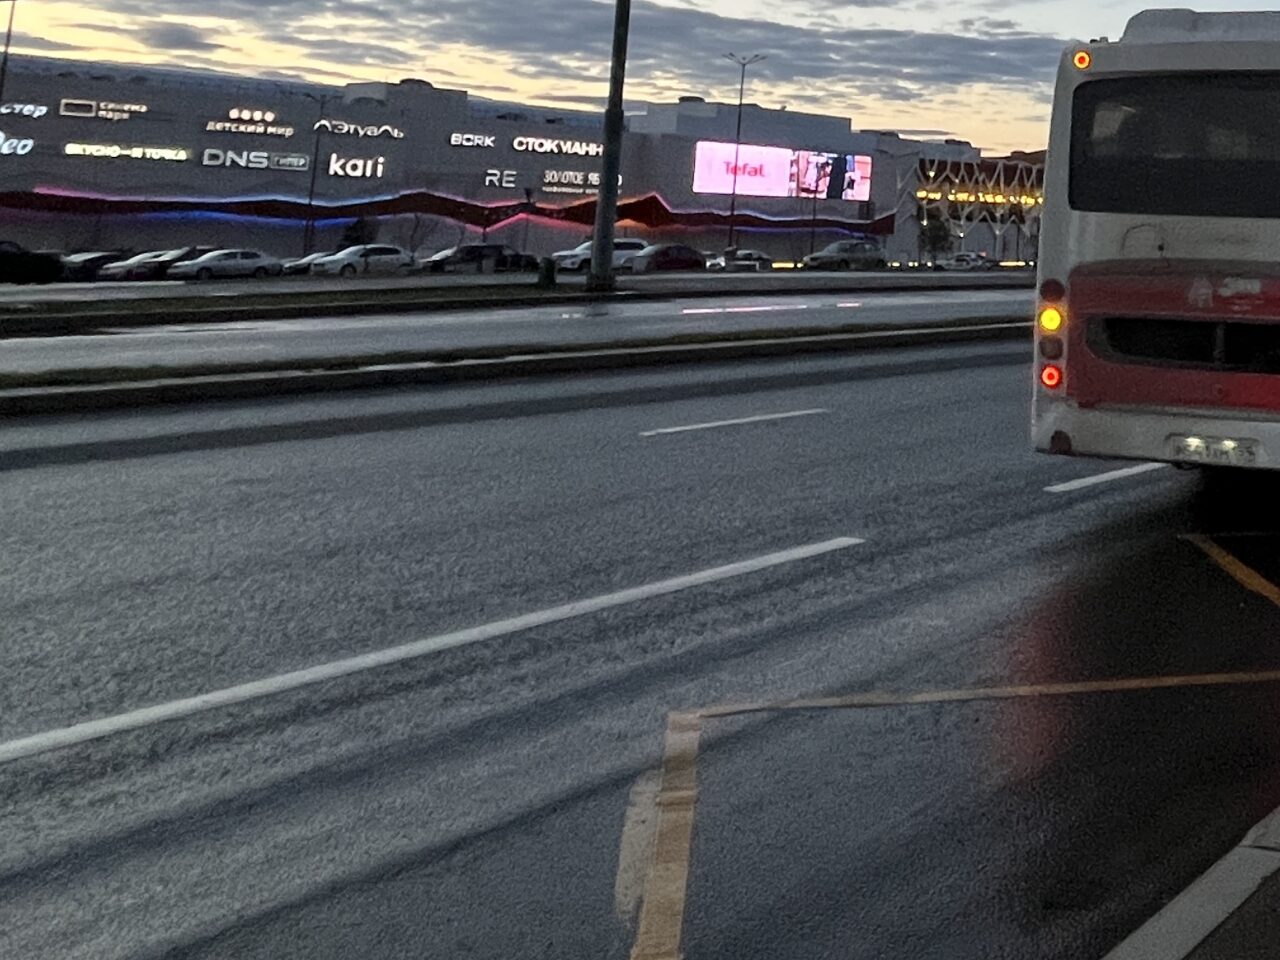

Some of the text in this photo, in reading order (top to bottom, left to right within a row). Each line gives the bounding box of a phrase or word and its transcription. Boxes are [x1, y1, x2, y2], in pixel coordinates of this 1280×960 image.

[206, 121, 295, 138] детский мир
[450, 133, 496, 147] BORK
[202, 148, 269, 168] DNS
[328, 153, 385, 178] kari
[723, 160, 766, 177] Tefal
[485, 169, 518, 188] RE
